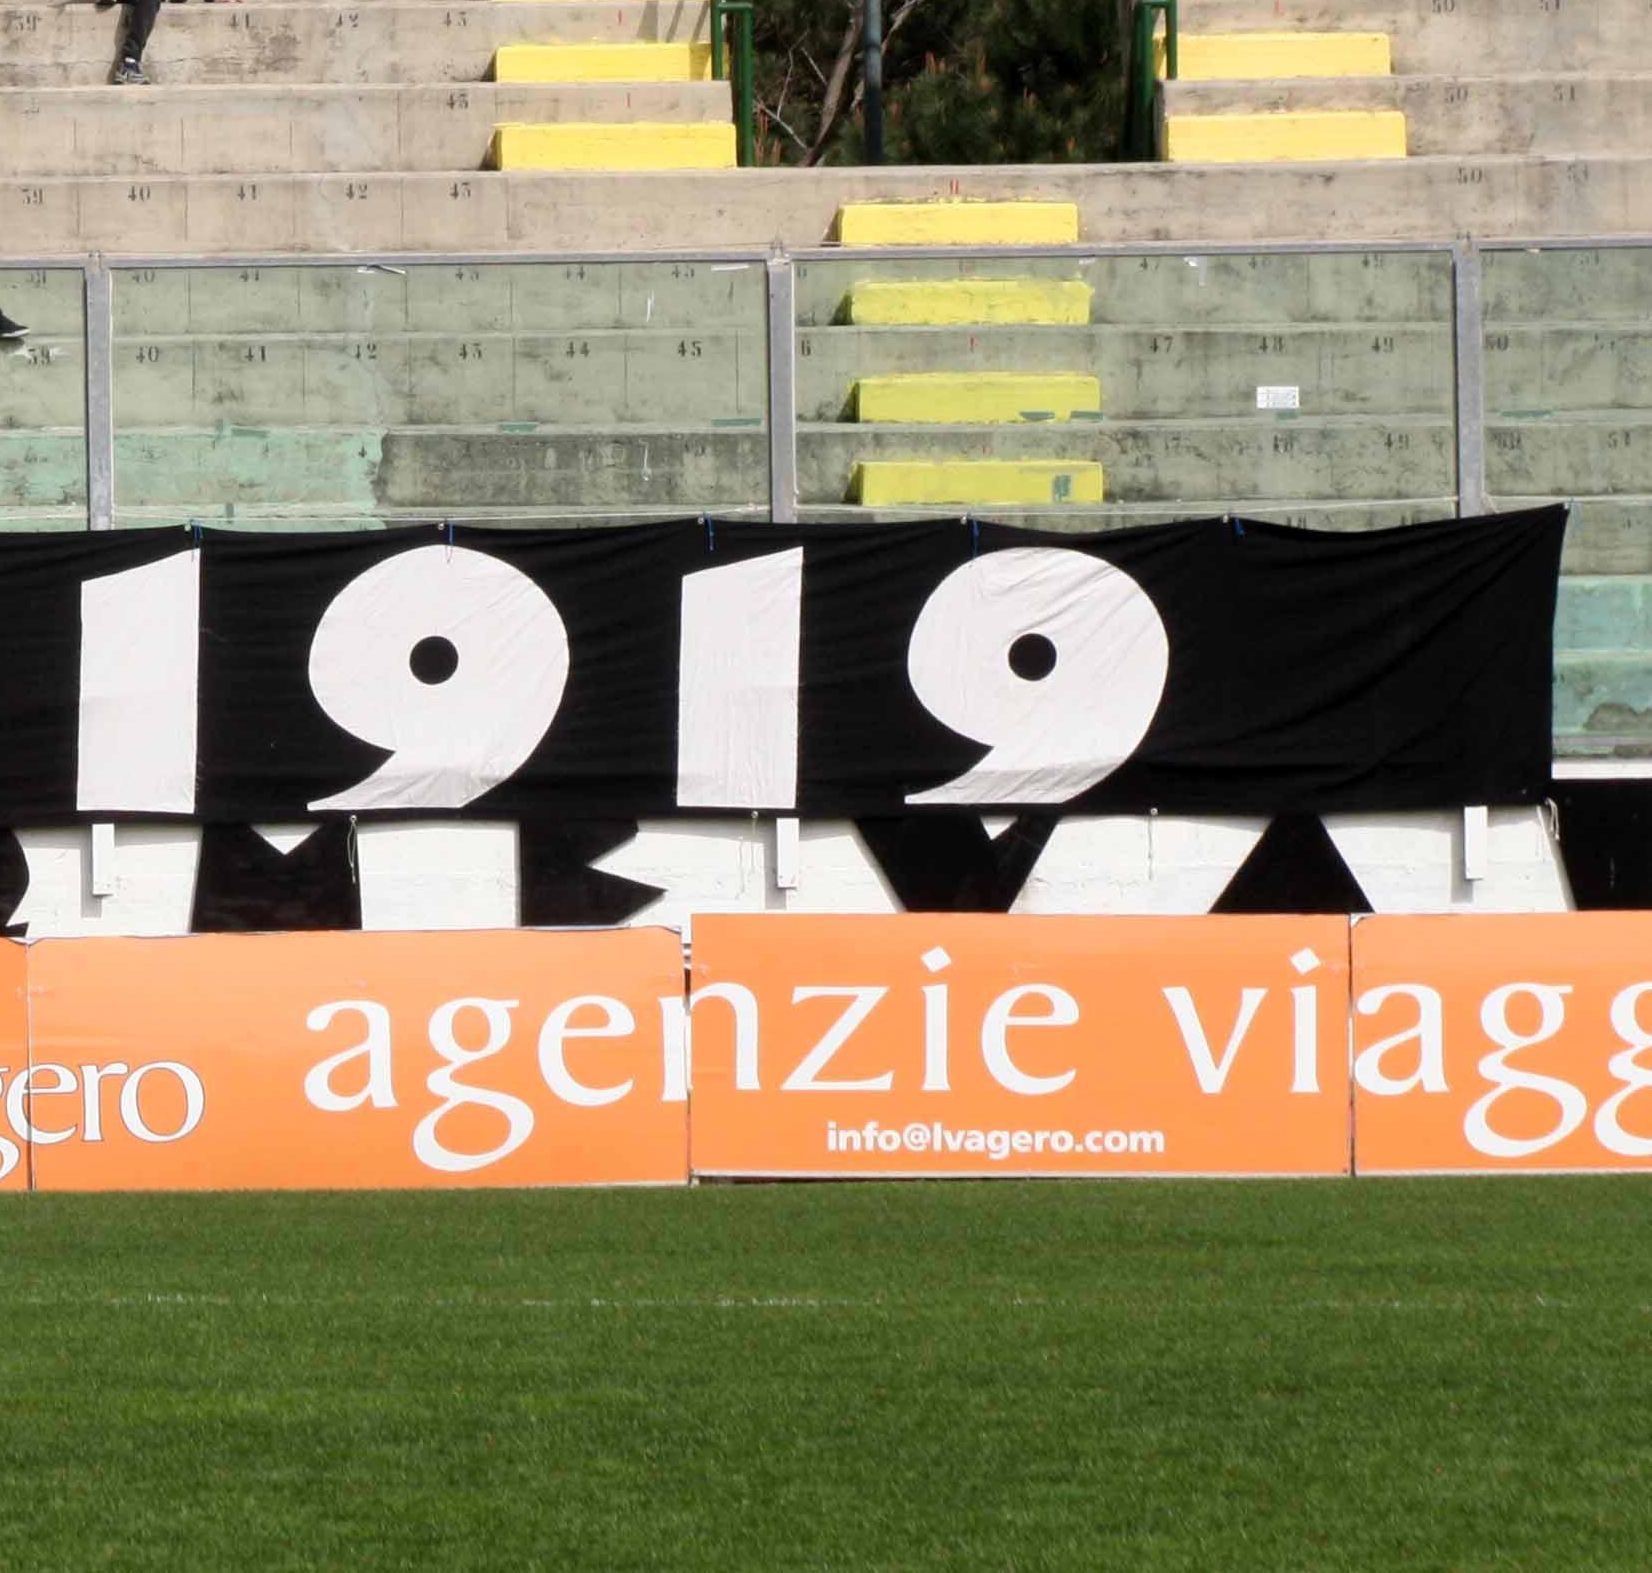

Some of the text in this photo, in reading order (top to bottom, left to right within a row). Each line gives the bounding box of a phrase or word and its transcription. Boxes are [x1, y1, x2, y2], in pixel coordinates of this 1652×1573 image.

[127, 185, 151, 202] 40
[237, 185, 258, 202] 41
[345, 183, 367, 200] 42
[567, 341, 590, 358] 44
[678, 340, 702, 358] 45
[1149, 337, 1173, 354] 47
[135, 347, 160, 364] 40
[244, 347, 266, 363] 41
[76, 543, 1168, 812] 1919
[302, 945, 1081, 1173] agenzie
